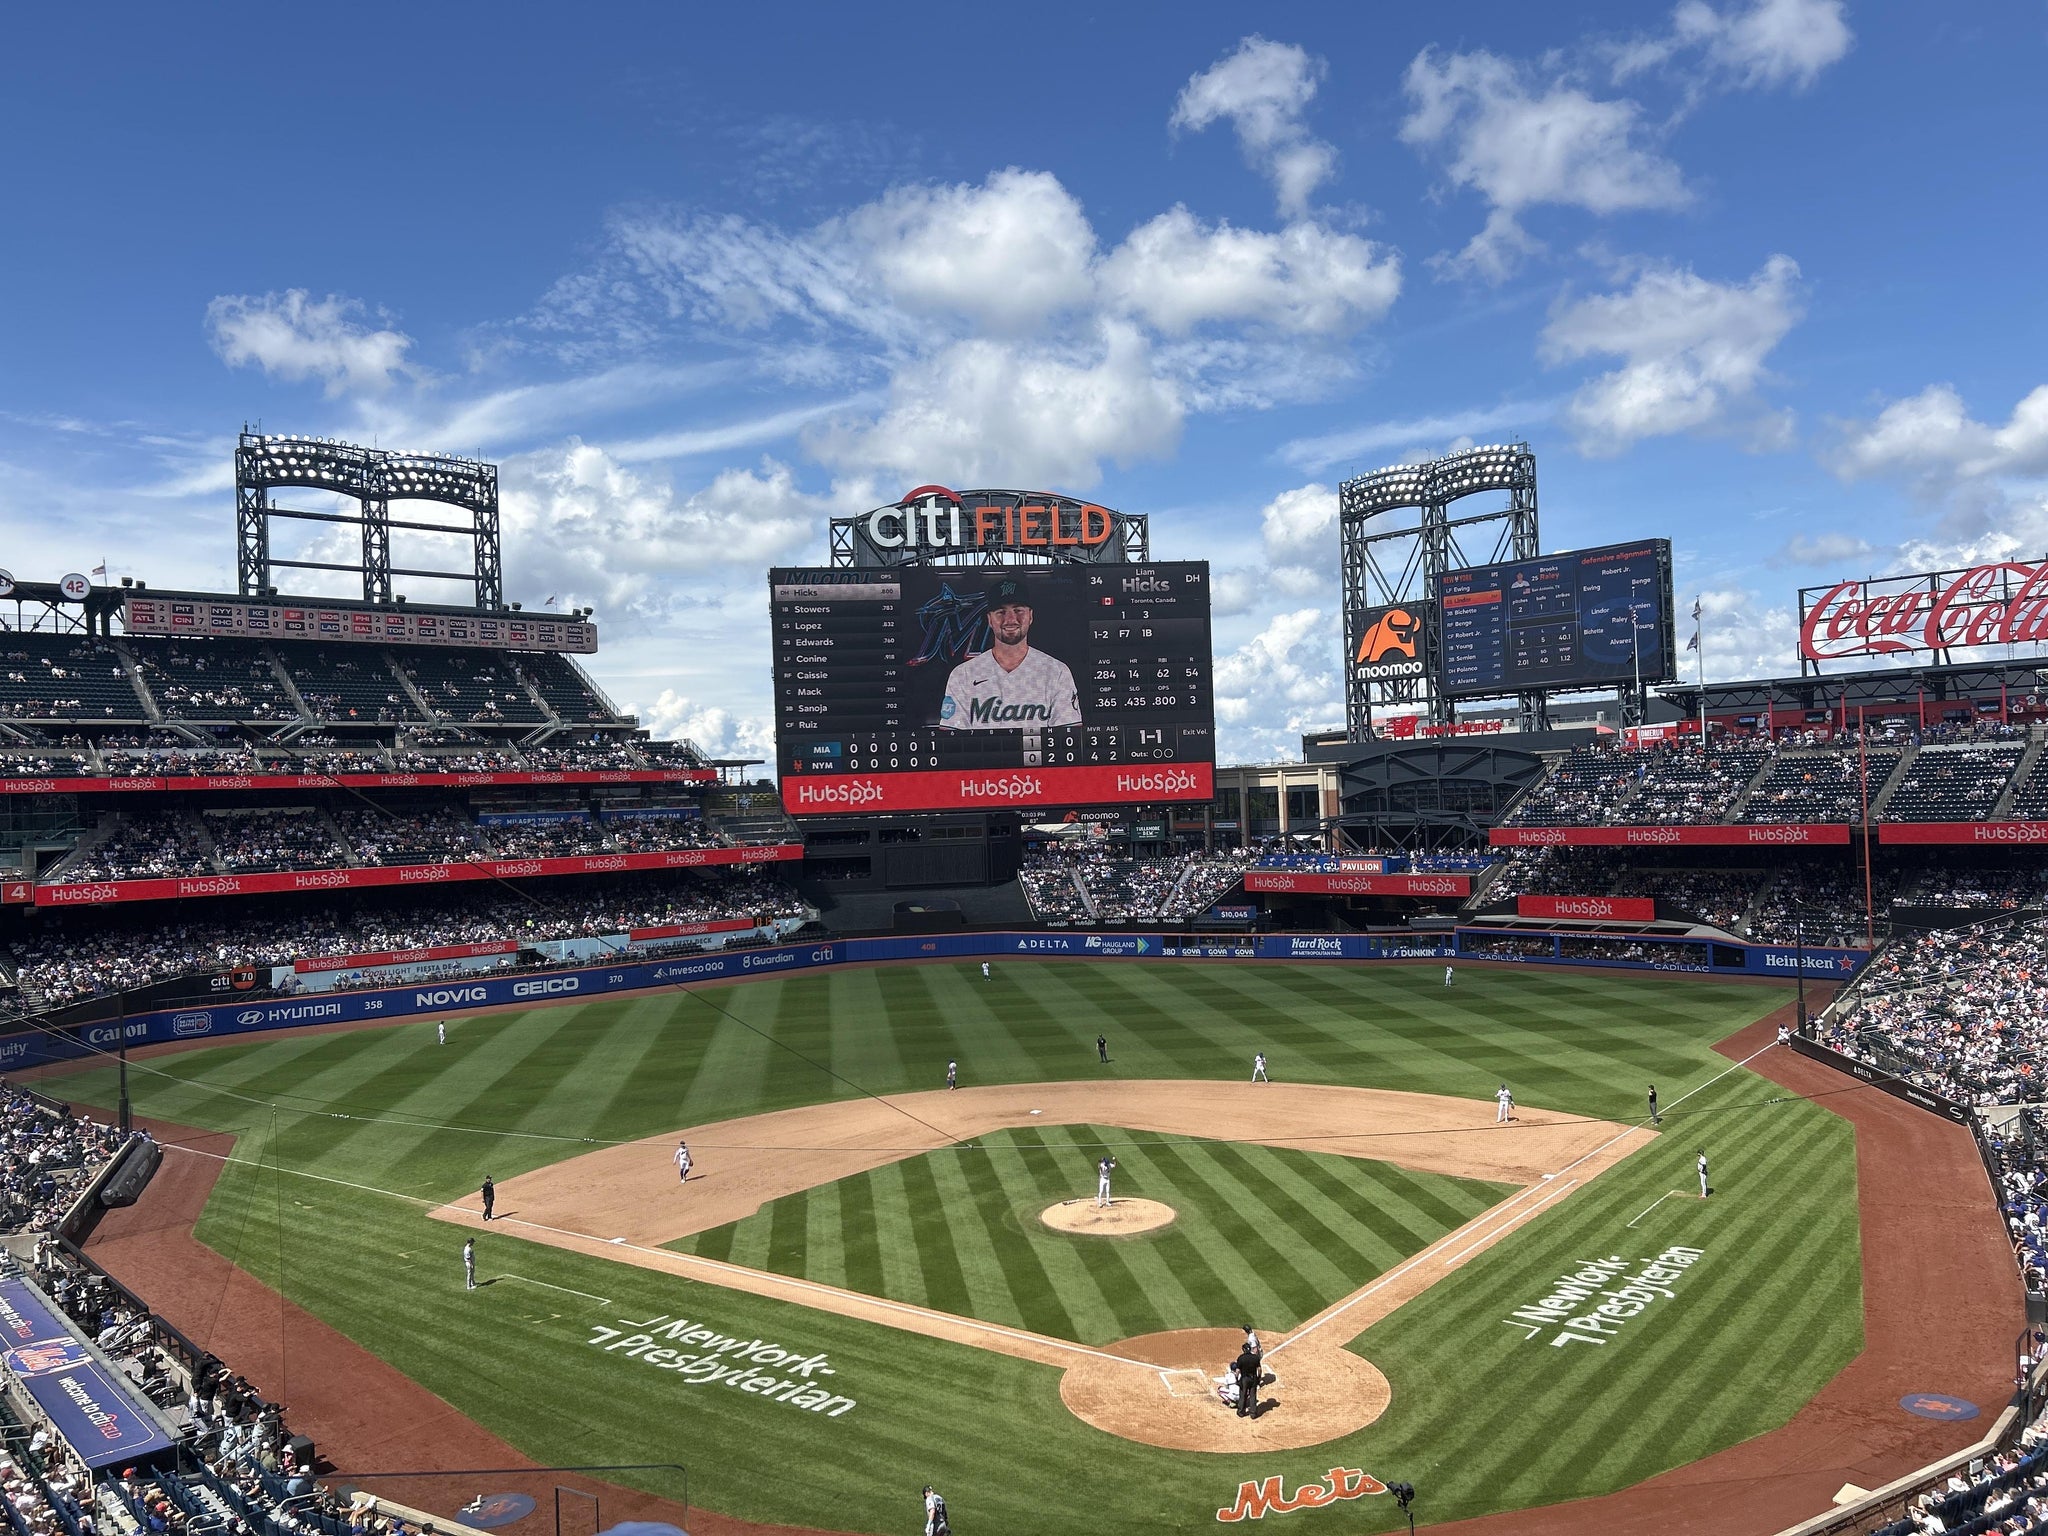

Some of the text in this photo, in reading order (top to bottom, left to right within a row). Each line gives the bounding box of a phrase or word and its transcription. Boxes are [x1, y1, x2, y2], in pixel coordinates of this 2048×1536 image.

[868, 494, 1112, 547] citi FIELD
[1616, 549, 1652, 559] alignment
[66, 580, 84, 592] 42
[1122, 577, 1170, 592] Hicks
[794, 589, 817, 597] Hicks
[1143, 611, 1149, 619] 3
[1800, 561, 2048, 659] Coca-Cola
[795, 622, 822, 631] Lopez
[1142, 629, 1152, 637] 1B
[796, 638, 834, 647] Edwards
[797, 655, 827, 663] Conine
[797, 671, 828, 679] Caissie
[1094, 671, 1116, 679] .284
[1129, 670, 1139, 678] 14
[1157, 669, 1169, 677] 62
[1357, 662, 1423, 680] moomoo
[1095, 696, 1196, 707] .365 .435 .800 3
[799, 704, 827, 713] Sanoja
[1421, 721, 1502, 736] new balance
[1140, 730, 1162, 744] 1-1
[850, 743, 857, 753] 0
[870, 743, 877, 752] 0
[890, 742, 897, 752] 0
[910, 742, 917, 751] 0
[1048, 738, 1054, 747] 3
[1066, 738, 1073, 746] 0
[1091, 737, 1097, 745] 3
[1110, 736, 1116, 745] 2
[851, 759, 858, 769] 0
[871, 759, 878, 768] 0
[891, 758, 898, 768] 0
[910, 757, 918, 767] 0
[930, 757, 937, 766] 0
[1048, 753, 1055, 762] 2
[1067, 753, 1074, 762] 0
[1091, 752, 1098, 760] 4
[1110, 751, 1116, 760] 2
[381, 775, 418, 785] HubSpot
[458, 774, 494, 784] HubSpot
[532, 772, 564, 783] HubSpot
[600, 771, 631, 781] HubSpot
[664, 771, 693, 780] HubSpot
[1118, 770, 1196, 793] HubSpot
[5, 780, 55, 792] HubSpot
[110, 779, 156, 790] HubSpot
[209, 778, 252, 789] HubSpot
[961, 775, 1042, 799] HubSpot
[800, 781, 883, 805] HubSpot
[1081, 812, 1119, 820] moomoo
[1519, 830, 1566, 843] HubSpot
[1628, 828, 1680, 843] HubSpot
[1749, 826, 1808, 843] HubSpot
[1975, 824, 2047, 841] HubSpot
[667, 852, 705, 865] HubSpot
[742, 848, 778, 860] HubSpot
[496, 861, 542, 876] HubSpot
[585, 857, 627, 871] HubSpot
[296, 872, 350, 887] HubSpot
[400, 866, 450, 881] HubSpot
[181, 878, 240, 894] HubSpot
[1255, 876, 1295, 890] HubSpot
[1328, 877, 1372, 891] HubSpot
[1408, 878, 1456, 894] HubSpot
[11, 885, 26, 899] 4
[53, 885, 118, 901] HubSpot
[1556, 899, 1612, 916] HubSpot
[680, 924, 708, 934] HubSpot
[472, 942, 506, 954] HubSpot
[921, 943, 936, 951] 408
[1030, 940, 1069, 949] DELTA
[1291, 938, 1342, 950] Hard Rock
[812, 948, 833, 962] citi
[1401, 949, 1436, 957] DUNKIN'
[1478, 954, 1525, 962] CADILLAC
[308, 958, 348, 970] HubSpot
[753, 954, 794, 966] Guardian
[1765, 954, 1833, 969] Heineken
[389, 965, 441, 976] LIGHT FIESTA
[669, 961, 724, 976] Invesco QQQ
[1654, 963, 1709, 972] CADILLAC
[211, 975, 230, 987] citi
[242, 972, 253, 981] 70
[609, 975, 623, 984] 370
[513, 977, 579, 996] GEICO
[416, 987, 487, 1007] NOVIG
[365, 1000, 383, 1010] 358
[269, 1003, 341, 1021] HYUNDAI
[1858, 1068, 1872, 1079] DELTA
[1564, 1246, 1704, 1335] Presbyterian
[604, 1334, 857, 1416] Presbyterian
[59, 1376, 100, 1413] welcome to
[1216, 1466, 1388, 1522] Mets
